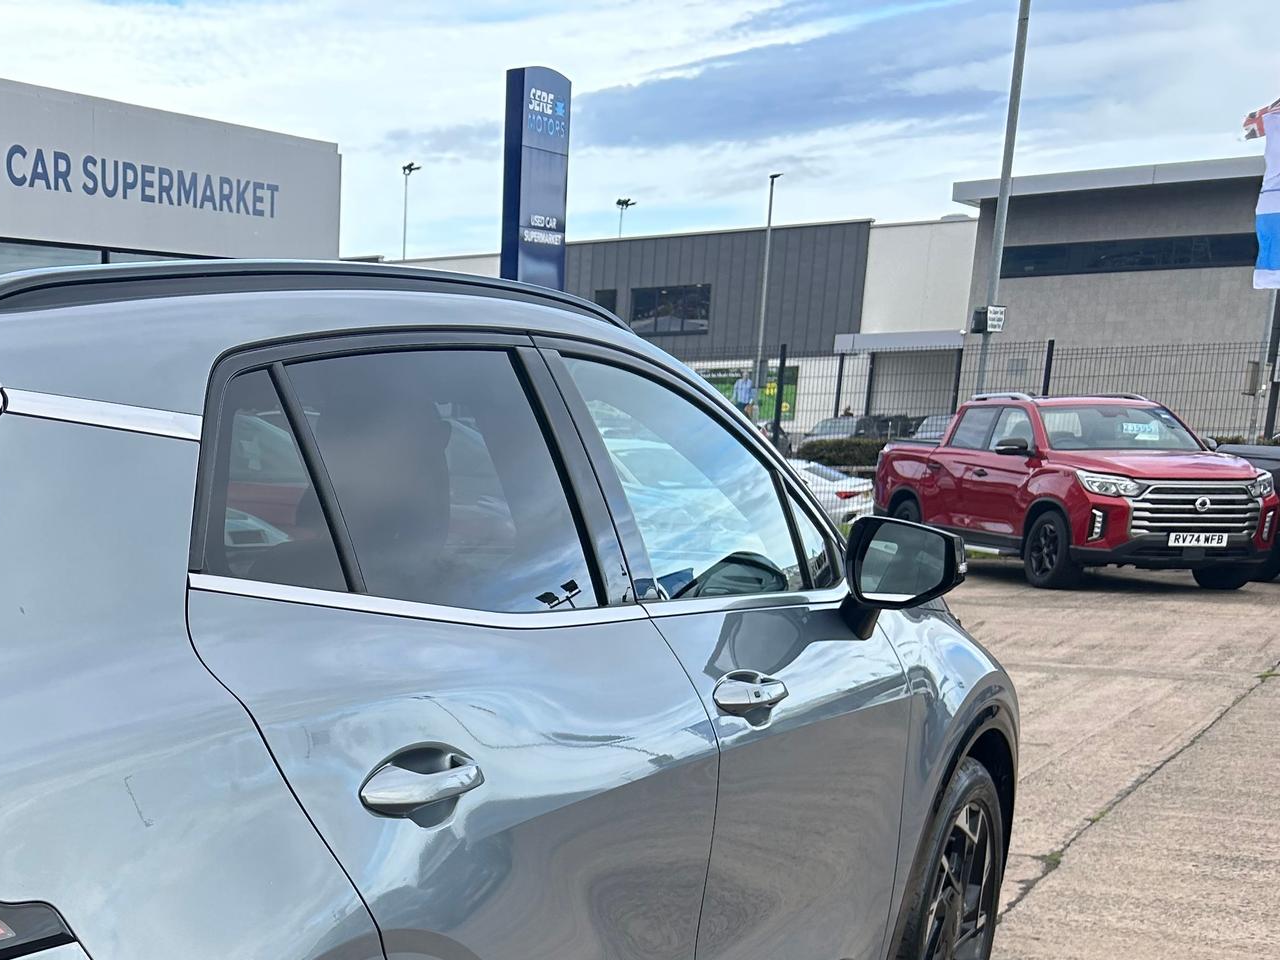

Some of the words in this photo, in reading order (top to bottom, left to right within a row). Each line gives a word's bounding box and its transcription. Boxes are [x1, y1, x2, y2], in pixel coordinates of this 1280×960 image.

[527, 113, 565, 138] MOTORS
[6, 144, 73, 193] CAR
[81, 155, 280, 219] SUPERMARKET
[530, 214, 545, 227] USED
[545, 216, 557, 230] CAR
[523, 229, 562, 246] SUPERMARKET
[1173, 533, 1201, 545] RV74
[1203, 534, 1224, 545] WFB
